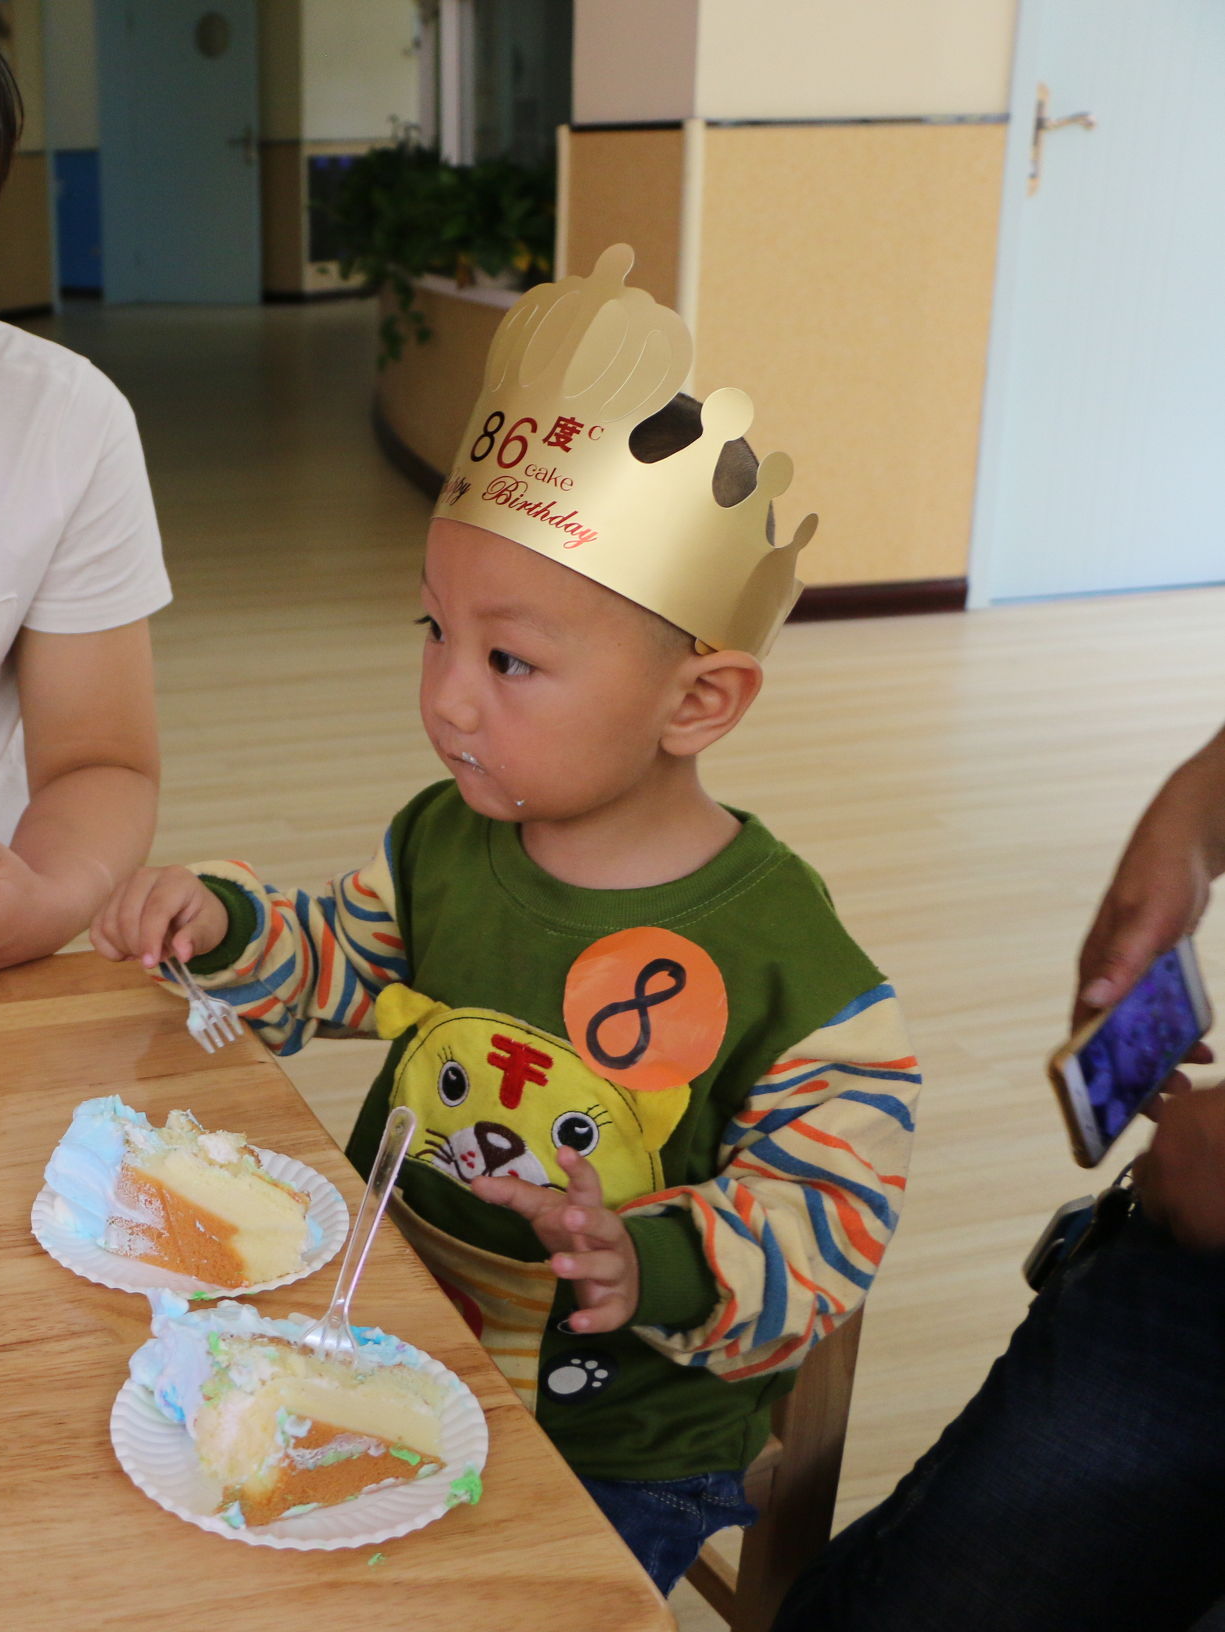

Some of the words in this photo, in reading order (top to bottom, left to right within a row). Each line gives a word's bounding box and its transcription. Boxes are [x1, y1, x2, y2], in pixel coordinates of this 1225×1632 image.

[482, 475, 598, 549] Birthday
[524, 463, 574, 491] cake
[586, 957, 686, 1069] 8
